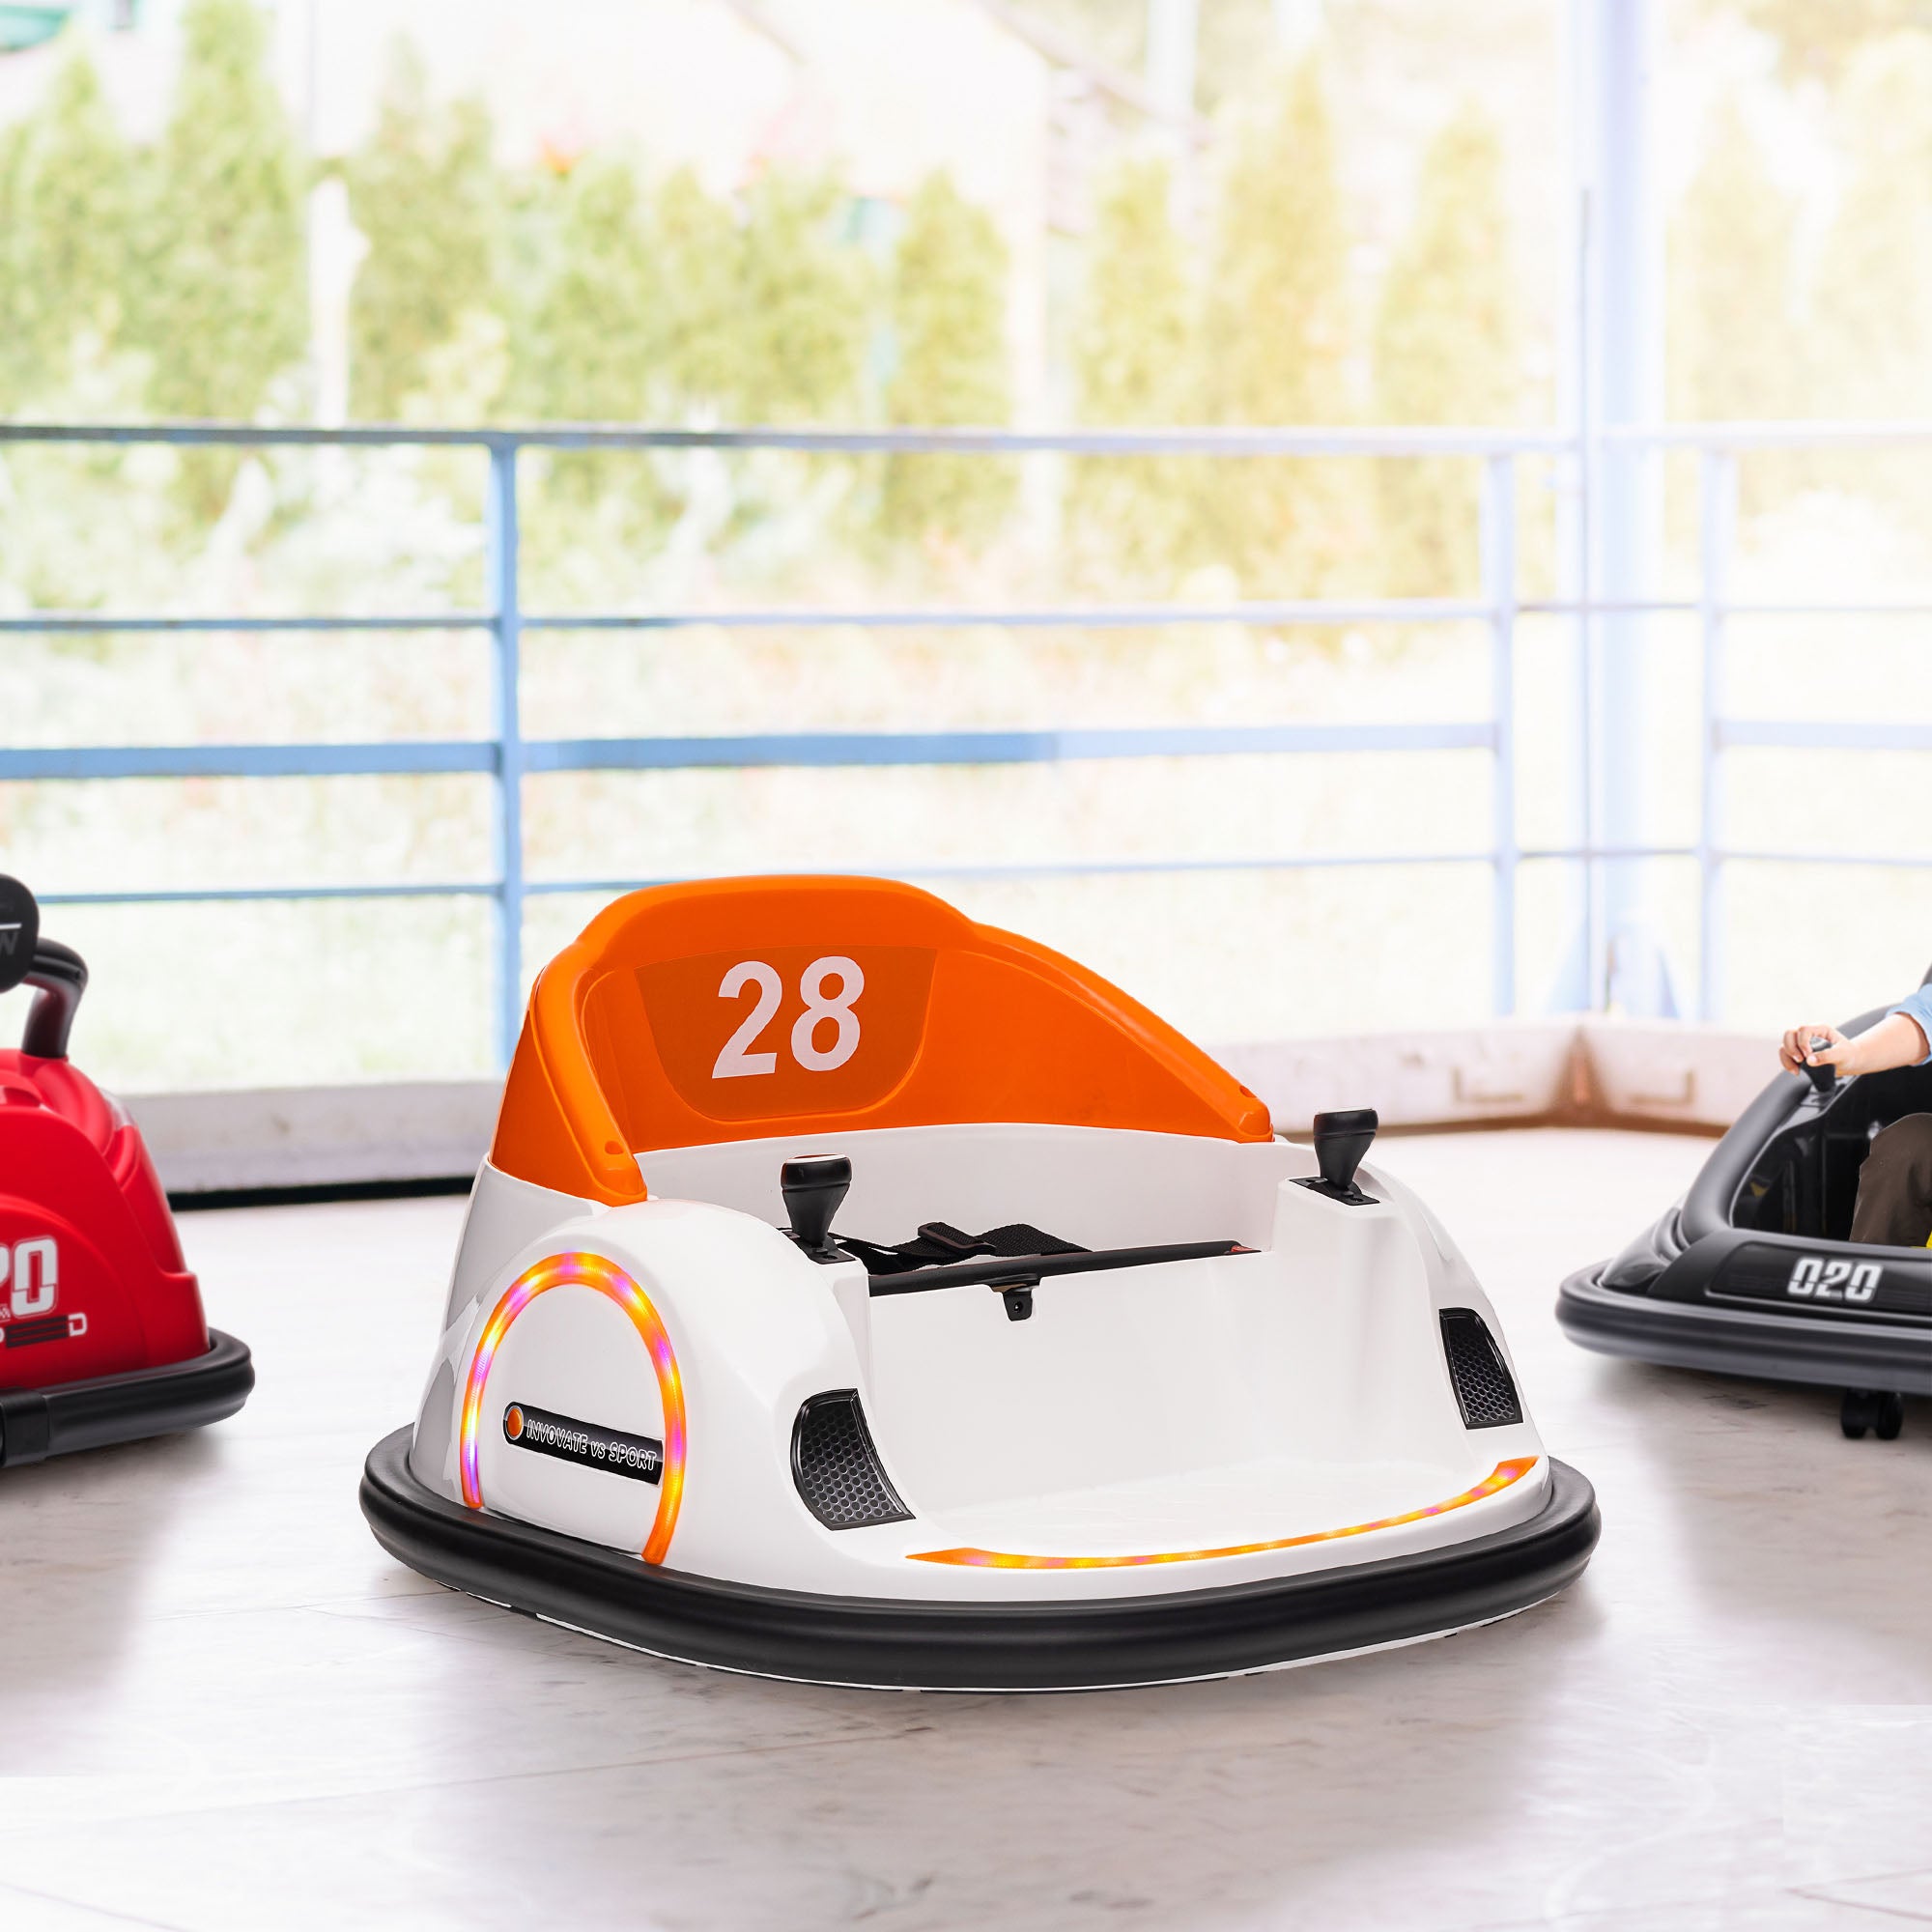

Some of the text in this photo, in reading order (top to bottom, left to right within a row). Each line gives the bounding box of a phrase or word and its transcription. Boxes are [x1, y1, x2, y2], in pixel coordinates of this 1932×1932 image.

[712, 955, 866, 1079] 28
[0, 1237, 58, 1317] 0
[1787, 1258, 1883, 1302] 020
[526, 1419, 588, 1455] INVOVATE
[609, 1441, 657, 1471] SPORT
